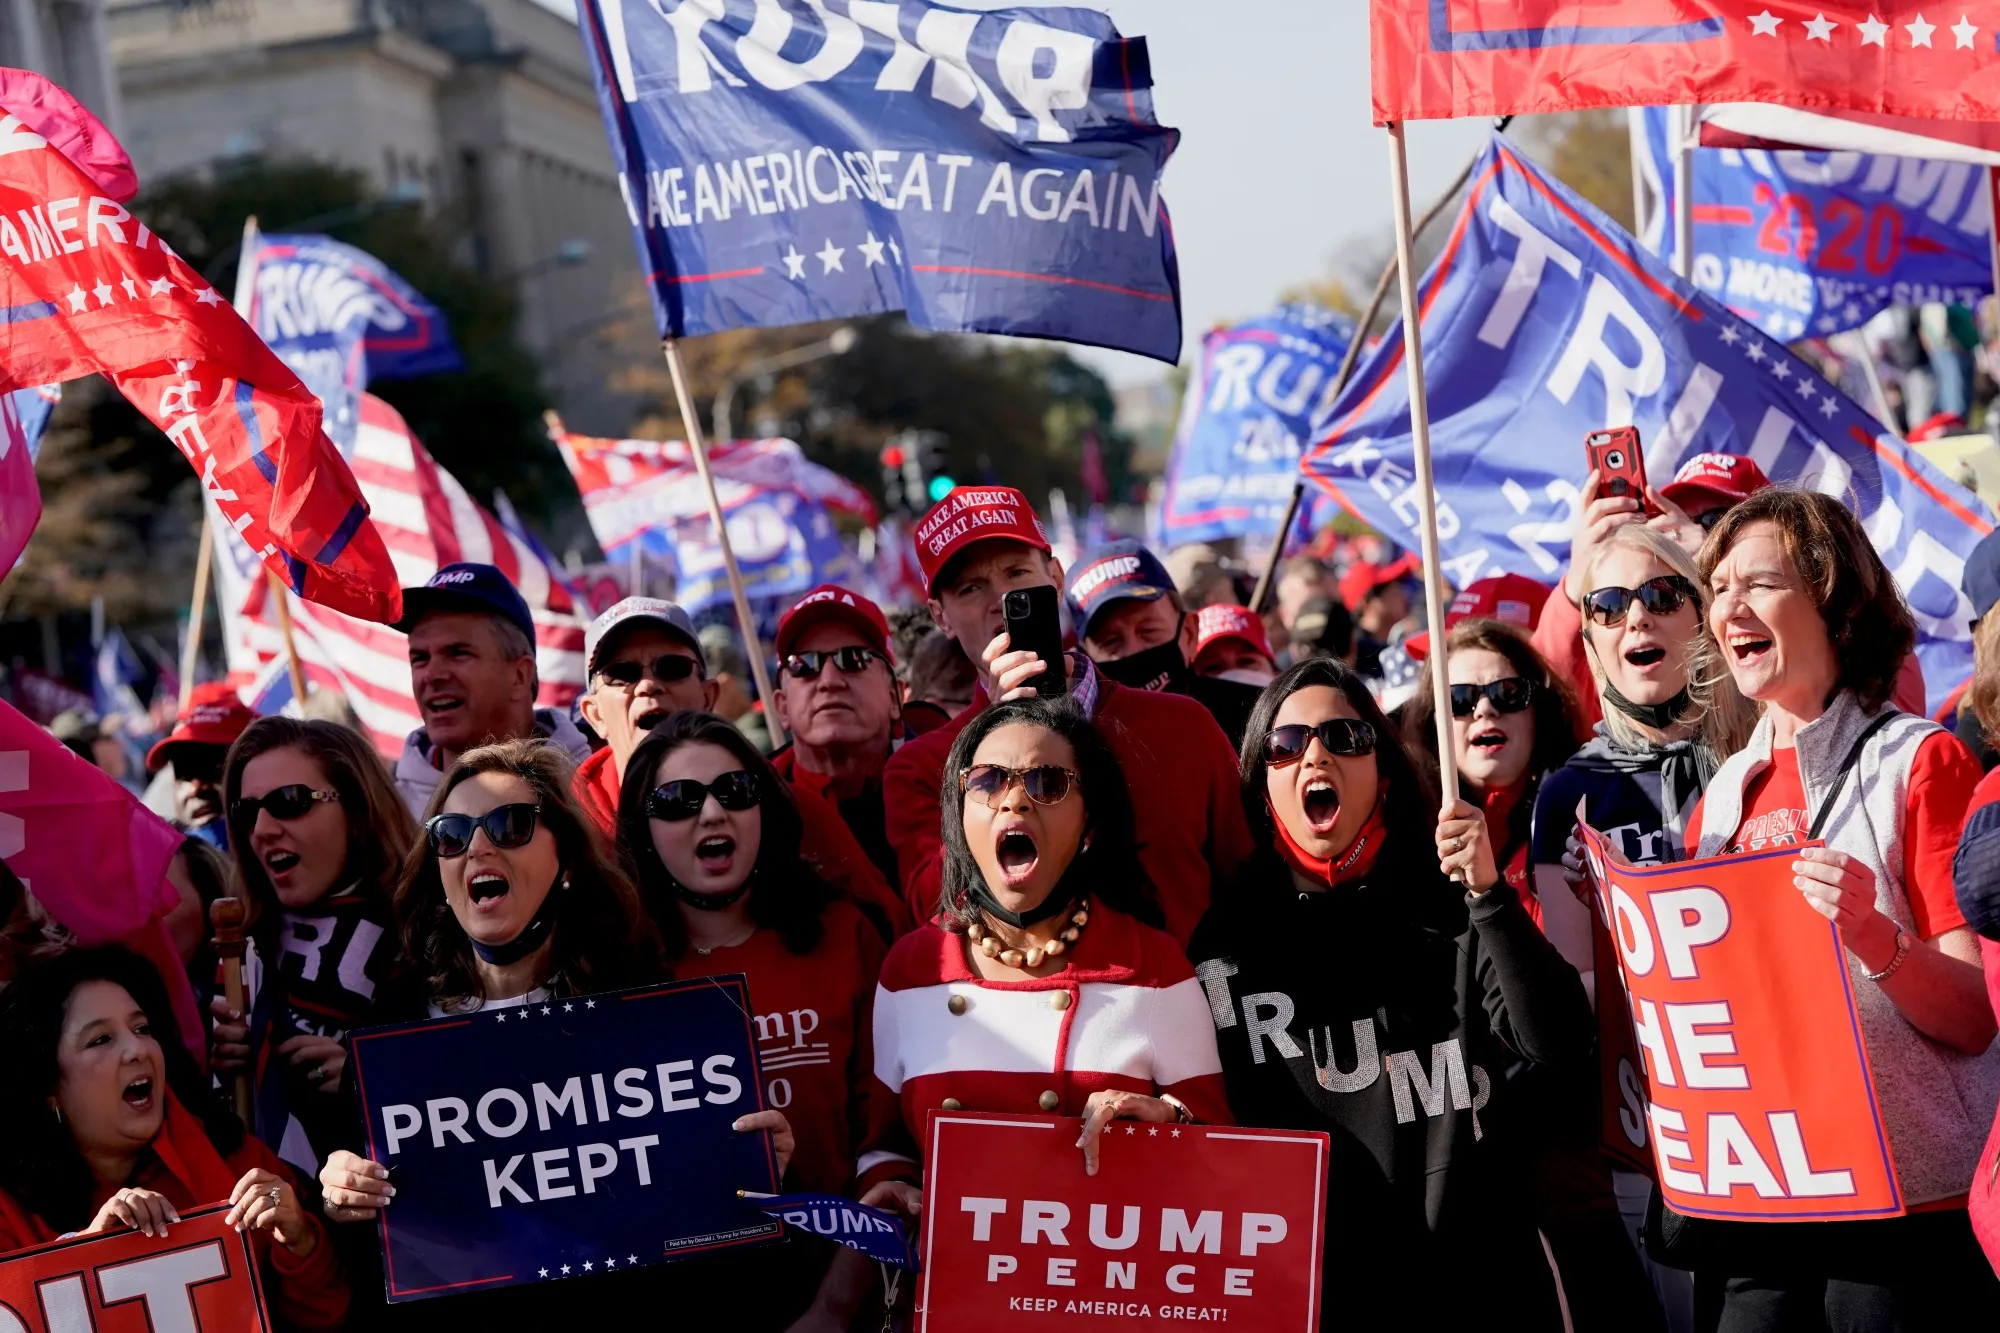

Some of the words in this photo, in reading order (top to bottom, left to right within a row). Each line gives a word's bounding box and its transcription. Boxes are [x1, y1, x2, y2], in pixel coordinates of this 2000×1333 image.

[619, 167, 692, 229] AKE
[976, 161, 1160, 238] AGAIN
[1726, 256, 1813, 314] MORE
[917, 503, 952, 545] MAKE
[951, 491, 1020, 515] AMERICA
[928, 517, 969, 556] GREAT
[971, 509, 1018, 529] AGAIN
[426, 571, 475, 588] UMP
[1070, 556, 1142, 601] TRUMP
[1340, 837, 1366, 872] TRUMP
[1598, 880, 1733, 981] OP
[1624, 985, 1752, 1090] HE
[381, 1054, 742, 1155] PROMISES
[482, 1134, 661, 1209] KEPT
[688, 1238, 694, 1246] by
[694, 1235, 712, 1244] Donald
[716, 1232, 732, 1241] Trump
[740, 1227, 764, 1237] President,
[761, 1208, 894, 1235] RUMP
[960, 1196, 1288, 1257] TRUMP
[0, 1242, 228, 1333] IT
[987, 1254, 1254, 1297] PENCE
[1009, 1297, 1058, 1313] KEEP
[1064, 1299, 1152, 1319] AMERICA
[1158, 1304, 1228, 1322] GREAT!
